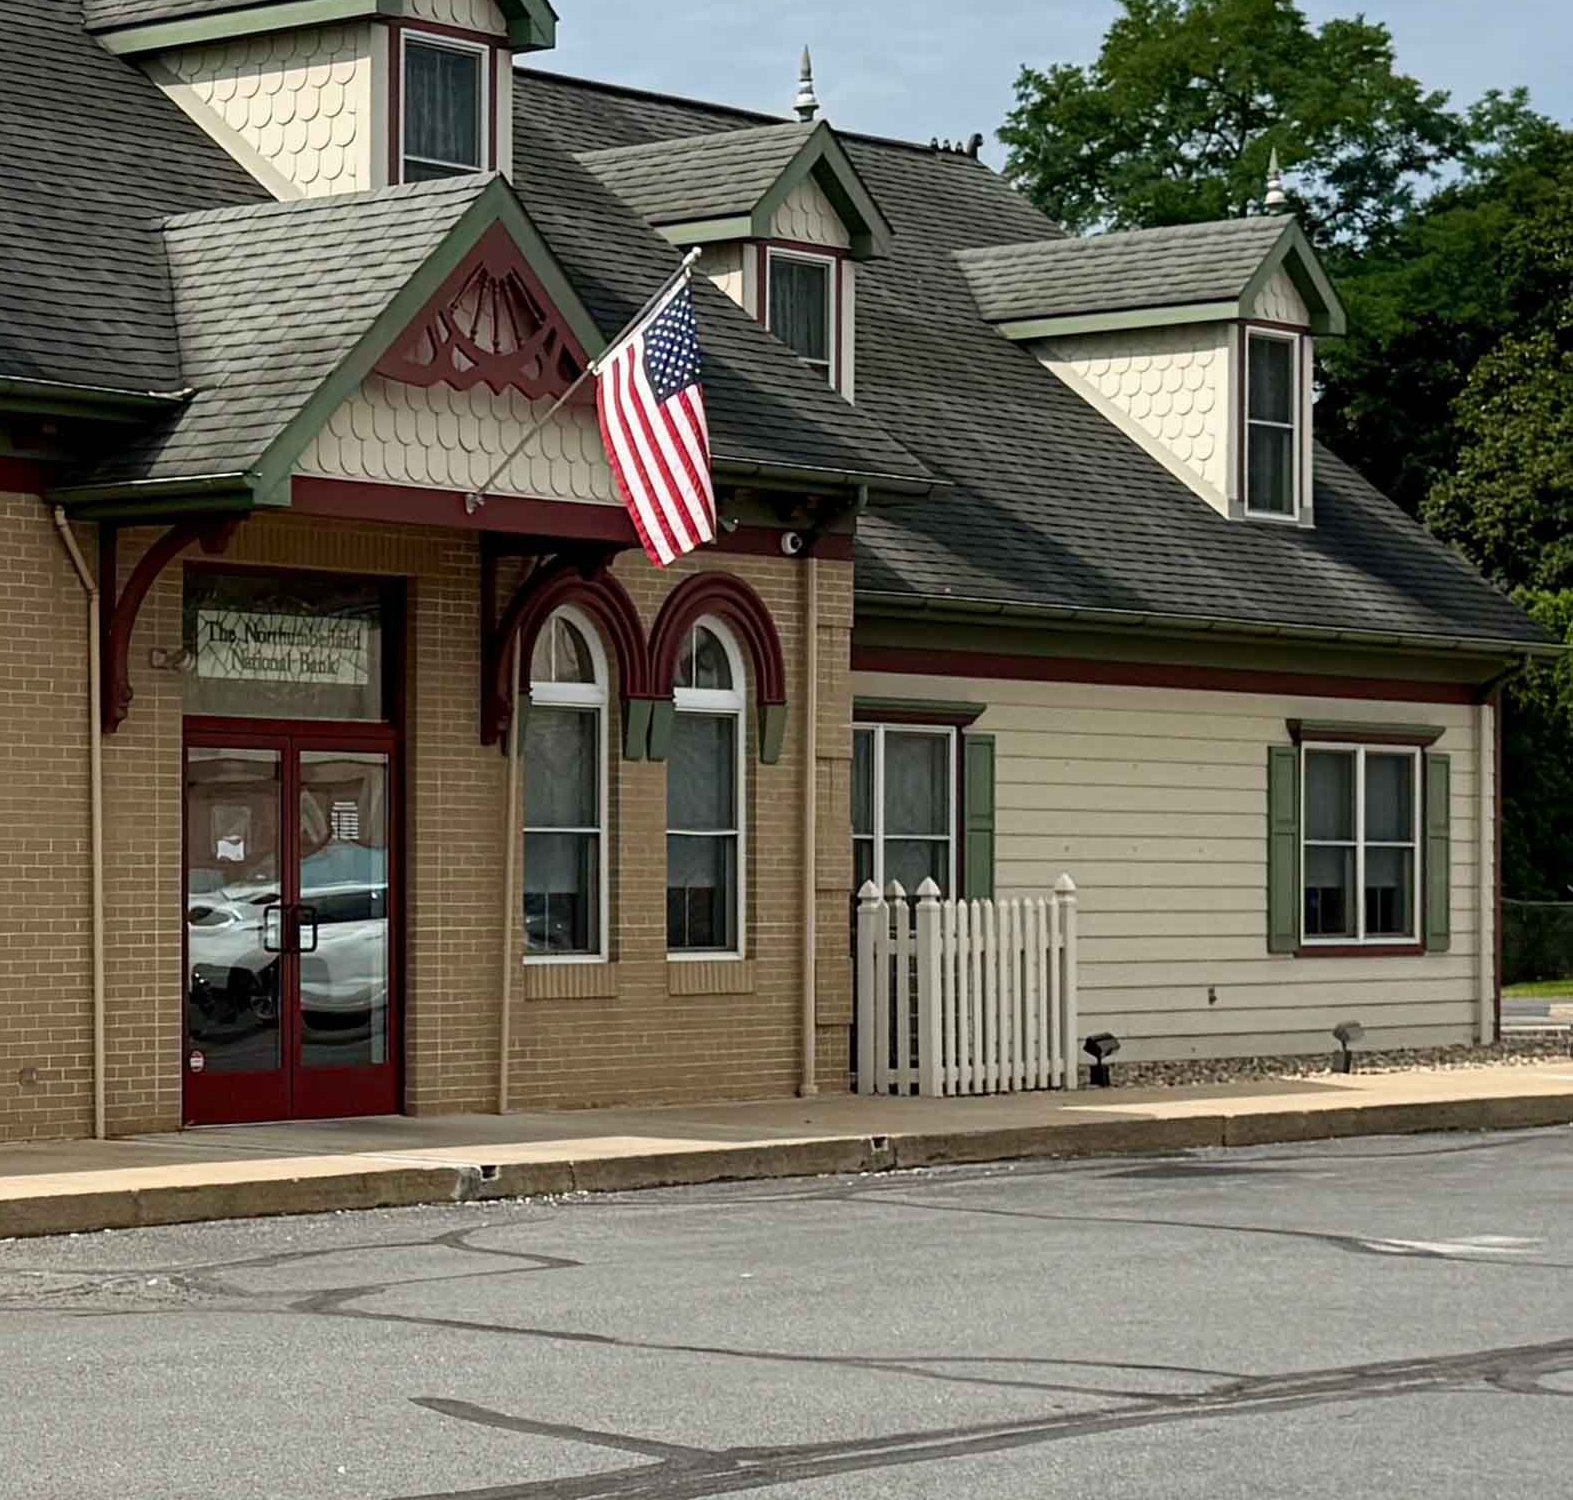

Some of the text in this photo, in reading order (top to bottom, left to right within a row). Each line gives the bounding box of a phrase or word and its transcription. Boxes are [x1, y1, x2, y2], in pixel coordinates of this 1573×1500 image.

[205, 620, 361, 650] The Northumberland
[231, 650, 338, 674] National Bank
